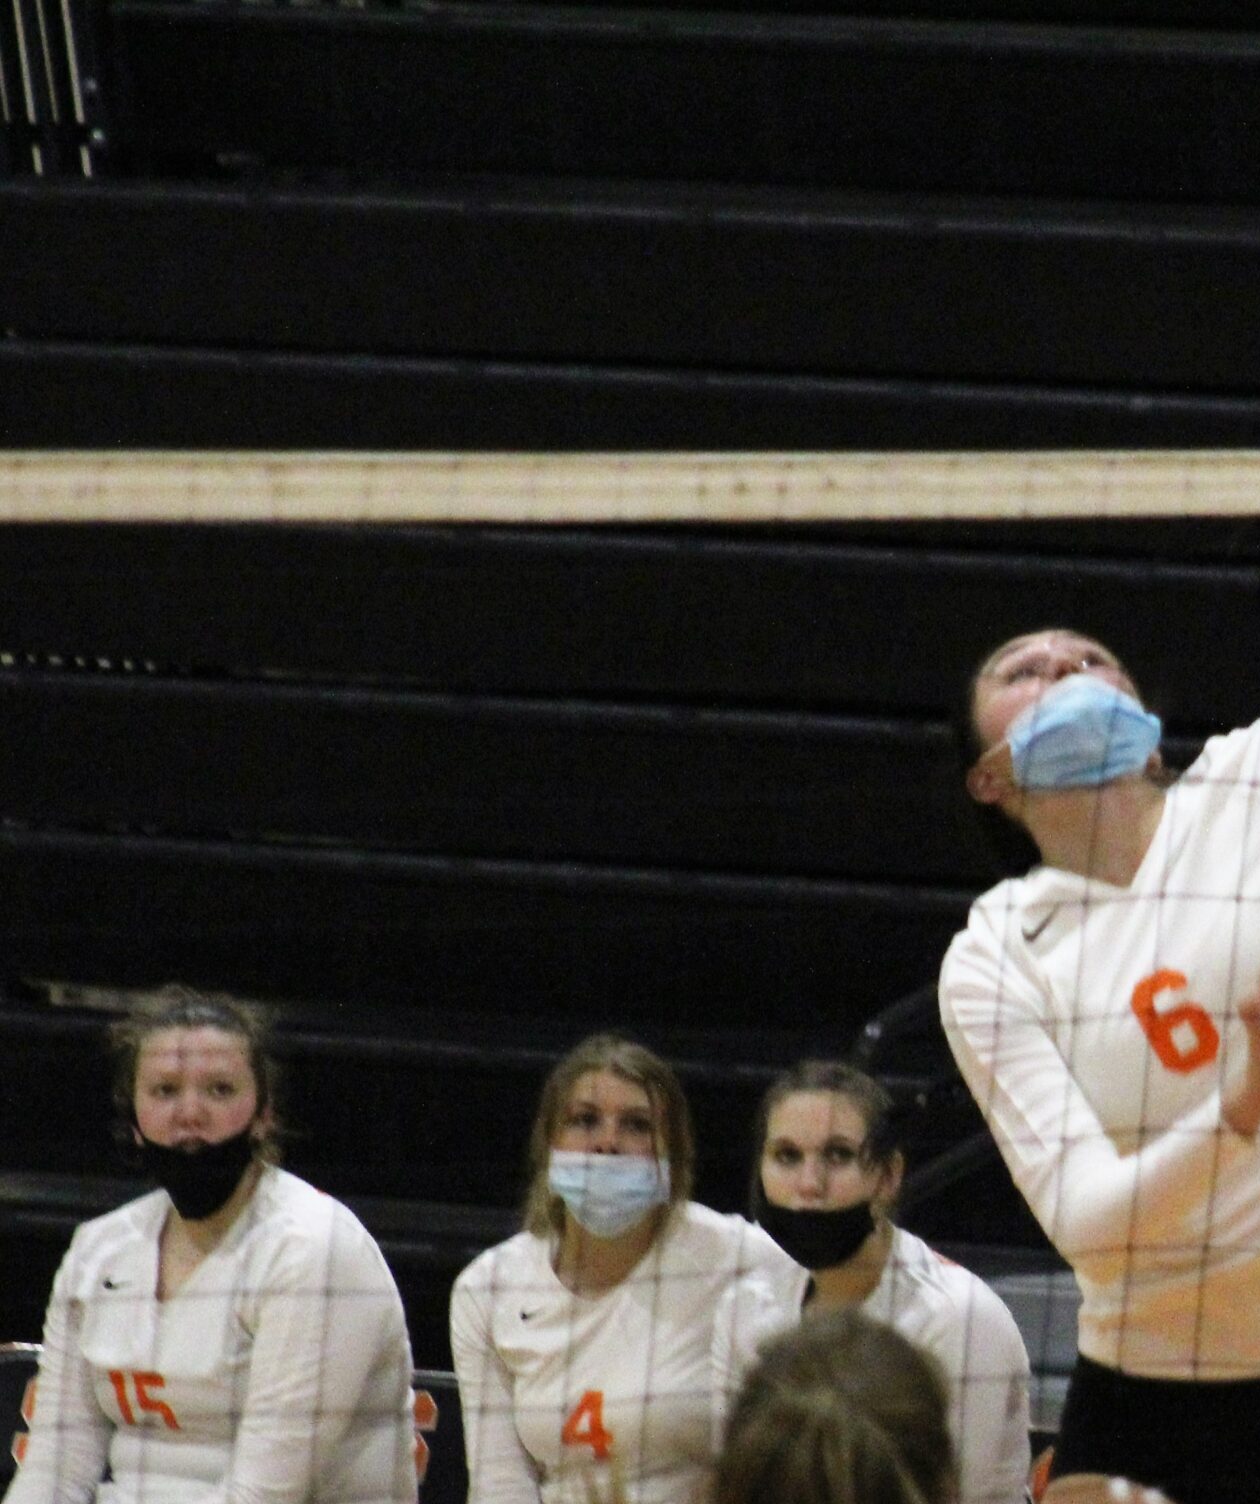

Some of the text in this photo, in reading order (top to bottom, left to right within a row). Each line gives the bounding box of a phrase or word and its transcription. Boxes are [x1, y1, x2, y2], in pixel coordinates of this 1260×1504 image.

[1130, 968, 1220, 1075] 6
[108, 1369, 181, 1431] 15
[561, 1390, 614, 1463] 4
